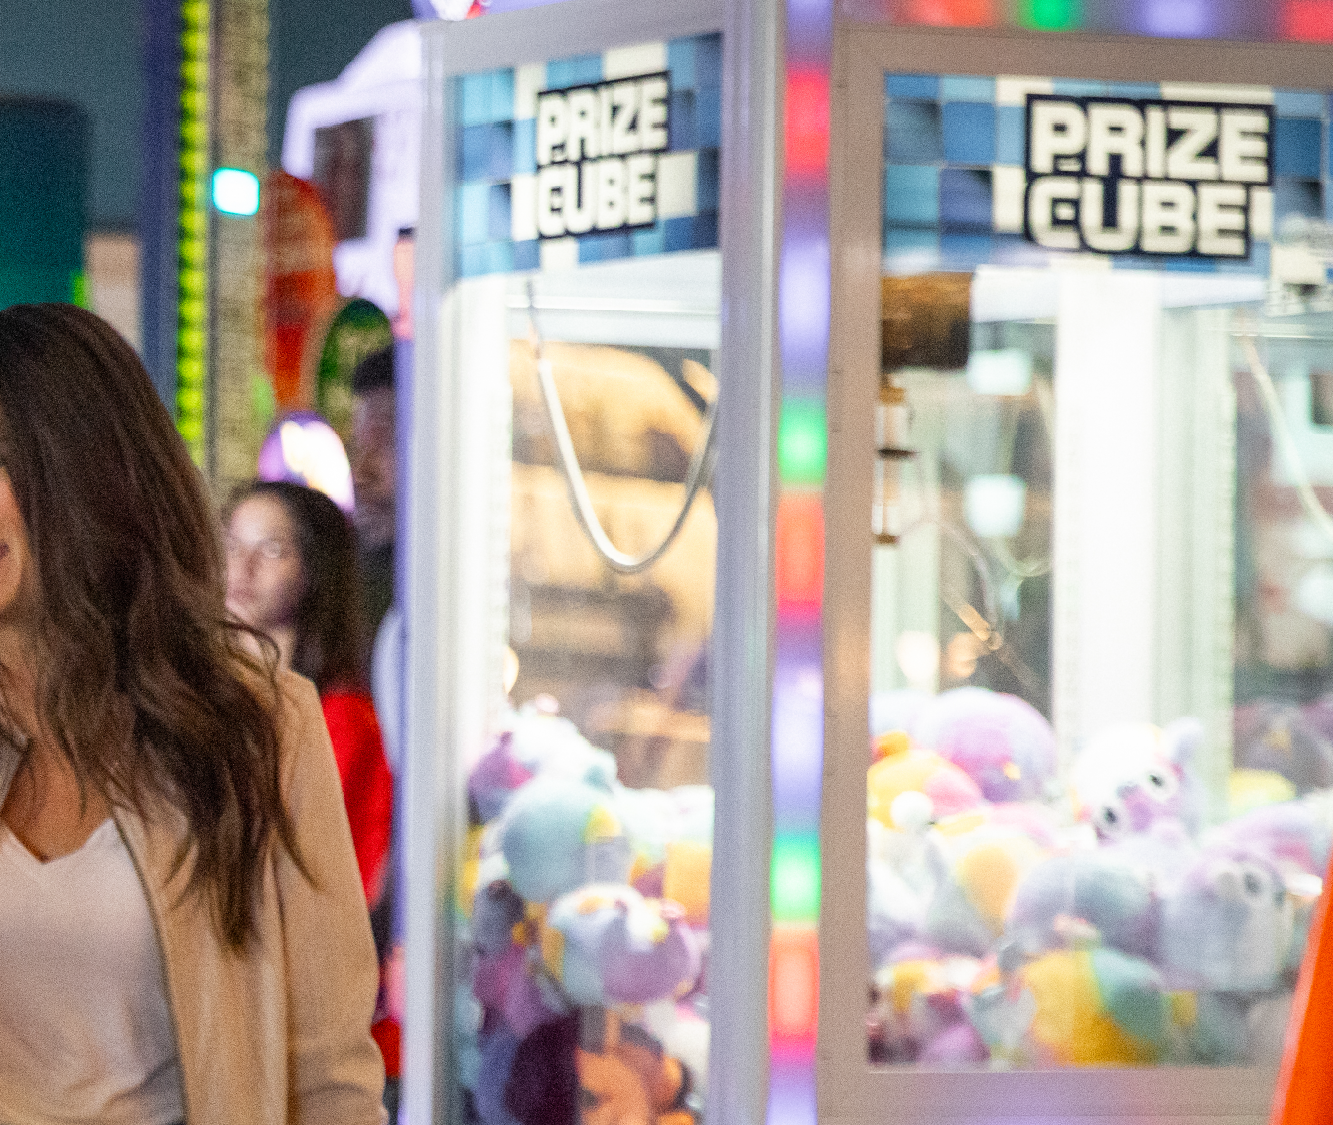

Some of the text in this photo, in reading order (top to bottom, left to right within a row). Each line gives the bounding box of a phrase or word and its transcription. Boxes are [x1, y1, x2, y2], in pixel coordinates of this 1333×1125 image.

[539, 76, 670, 162] PRIZE
[1028, 99, 1272, 182] PRIZE
[539, 157, 657, 236] CUBE
[1027, 179, 1250, 257] CUBE
